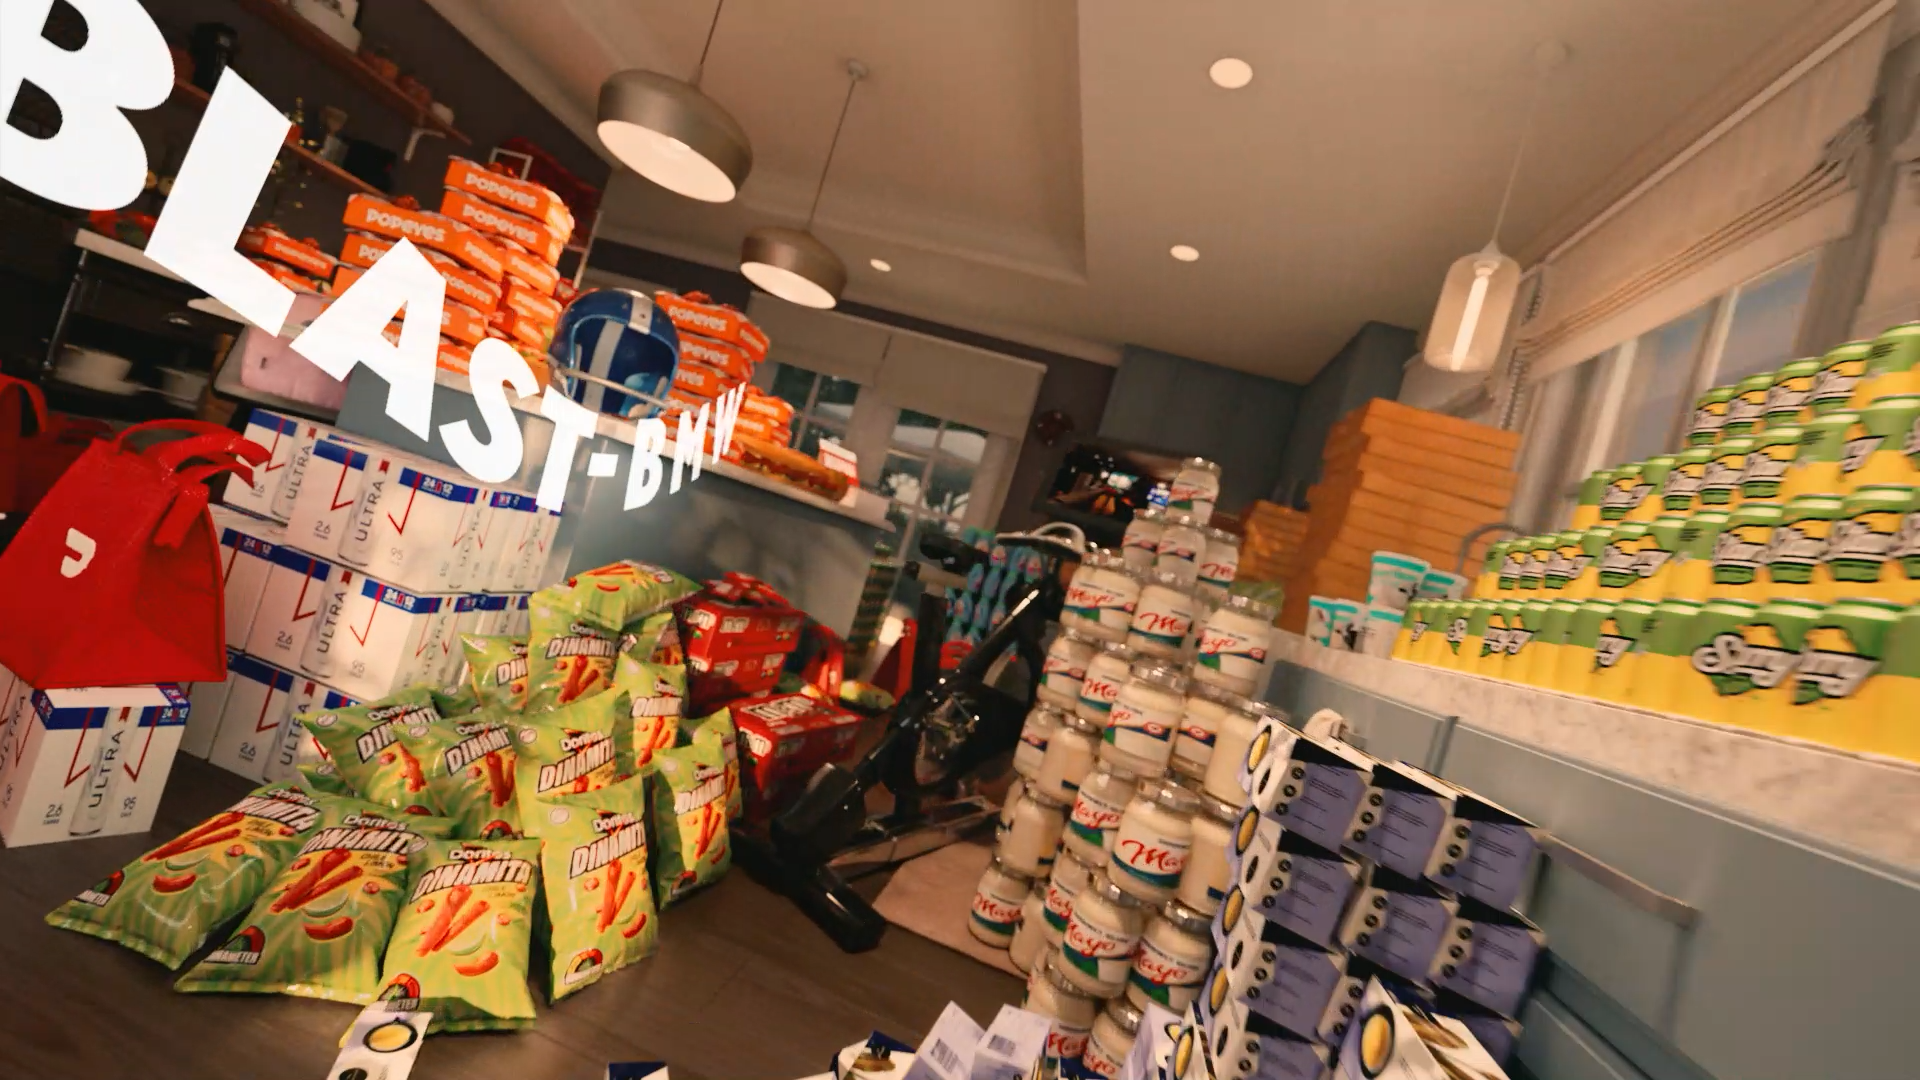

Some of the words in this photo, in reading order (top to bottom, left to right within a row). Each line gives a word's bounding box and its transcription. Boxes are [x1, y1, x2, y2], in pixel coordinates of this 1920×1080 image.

[285, 445, 313, 500] ULTRA
[354, 480, 385, 542] ULTRA
[317, 591, 347, 654] ULTRA
[88, 730, 125, 809] ULTRA
[409, 858, 533, 905] DINAMITA
